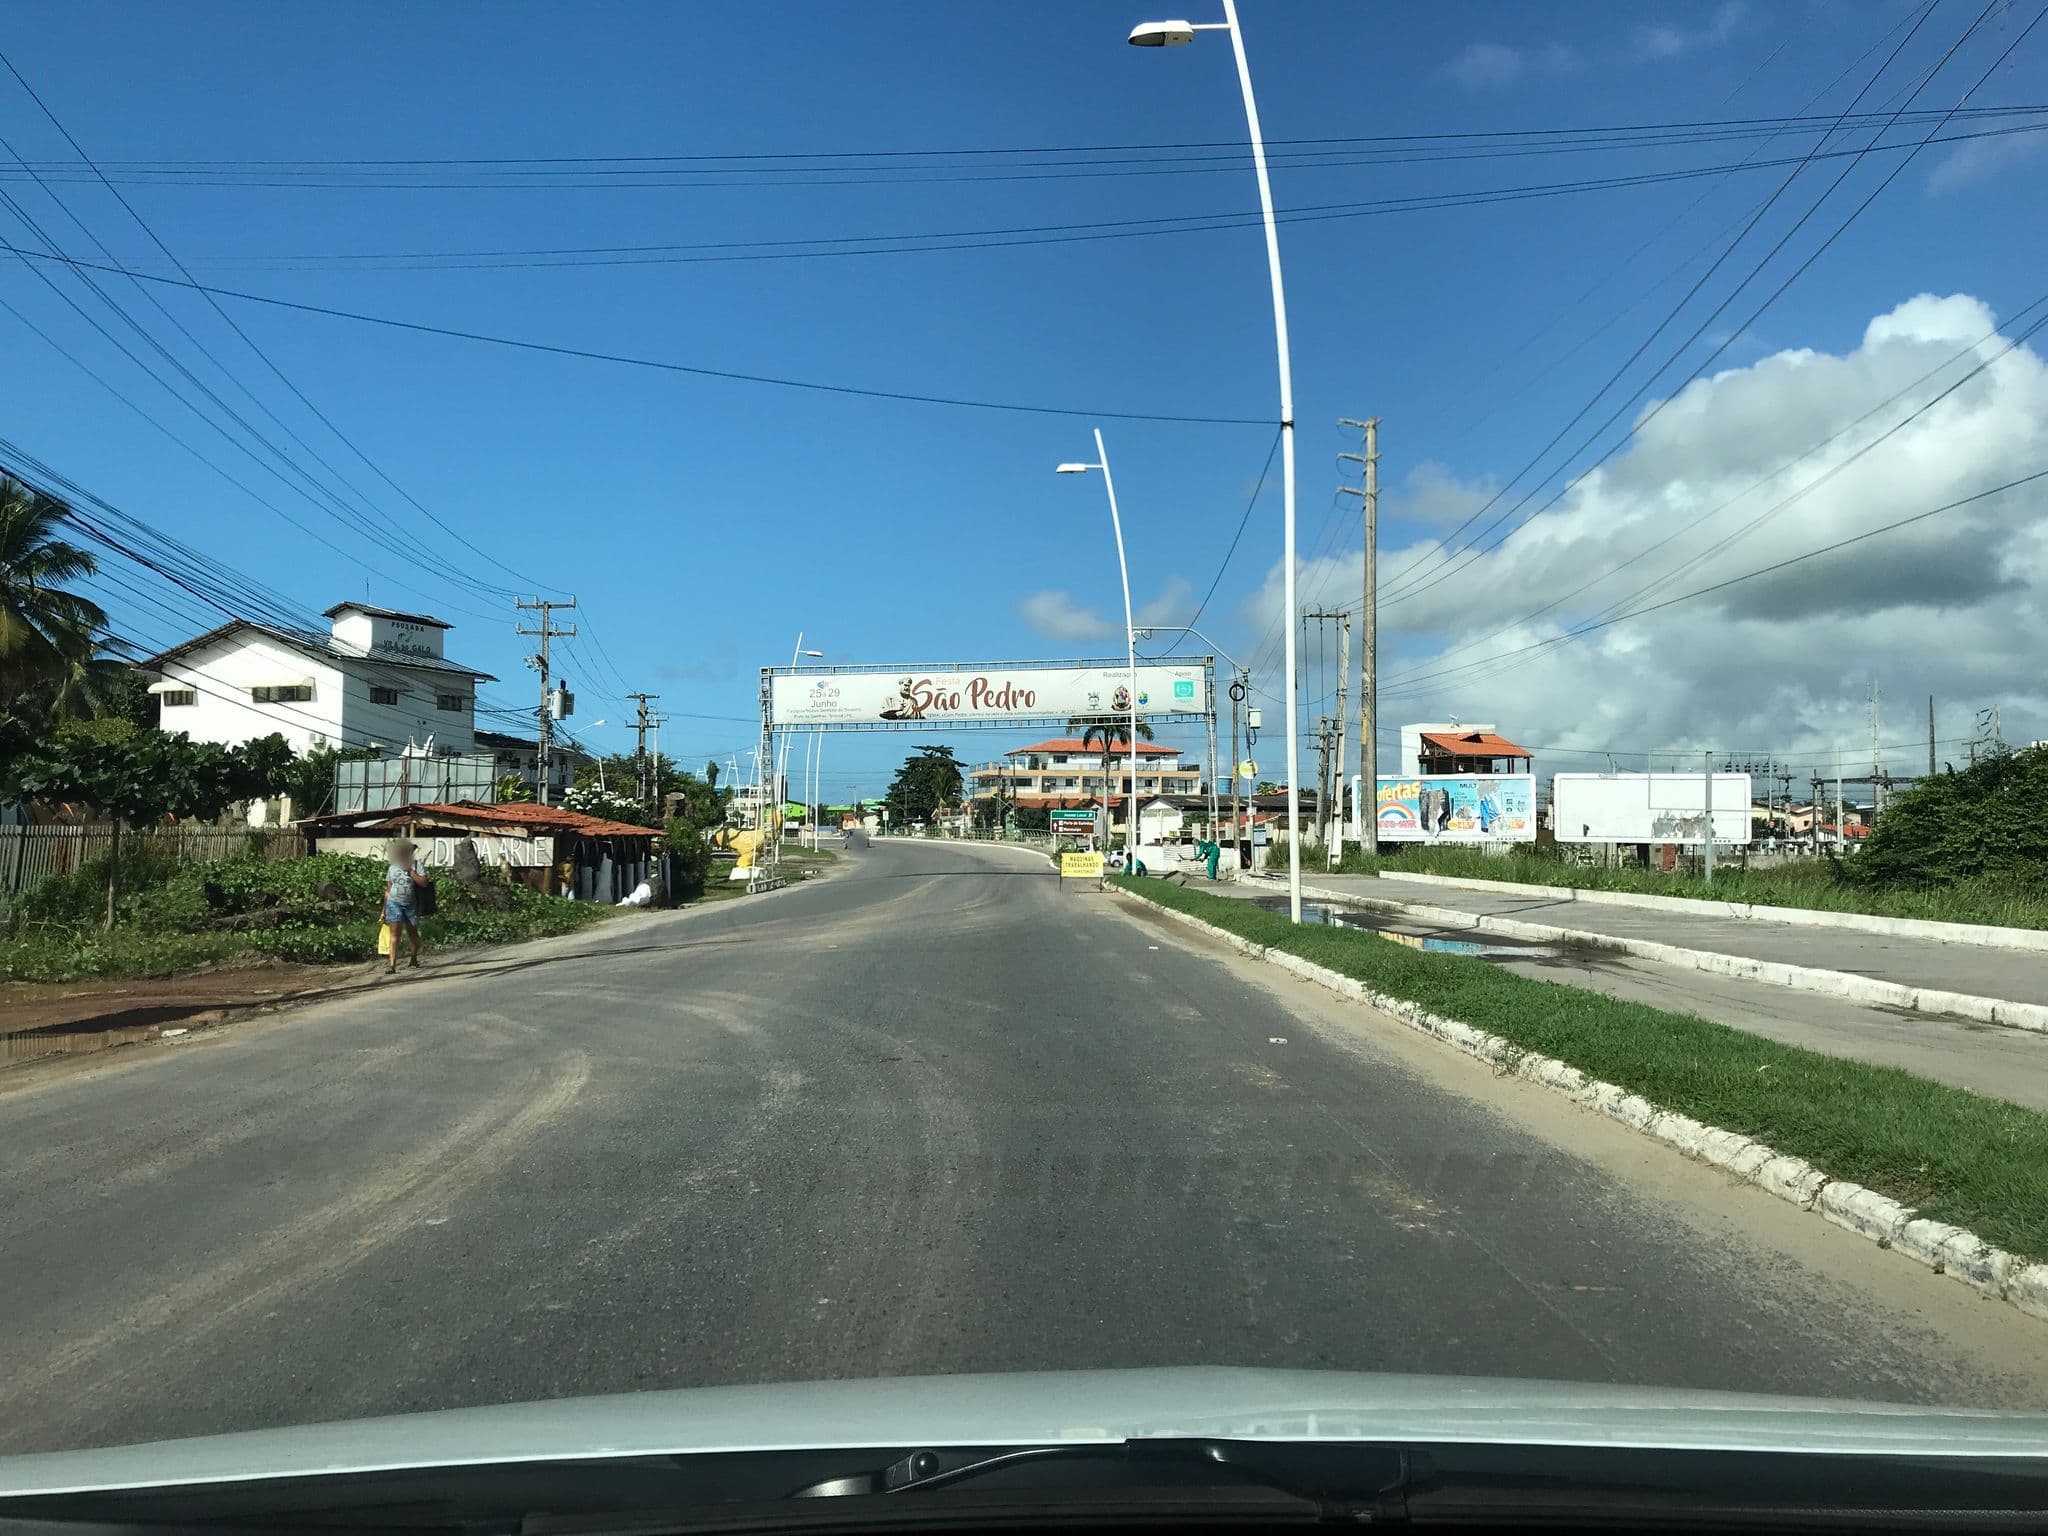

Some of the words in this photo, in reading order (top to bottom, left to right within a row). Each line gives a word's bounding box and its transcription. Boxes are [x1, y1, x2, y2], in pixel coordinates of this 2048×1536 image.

[391, 621, 425, 633] POUSADA
[809, 688, 822, 698] 25
[828, 688, 841, 697] 29
[911, 678, 960, 712] São
[964, 677, 1036, 711] Pedro
[811, 699, 837, 708] Junho
